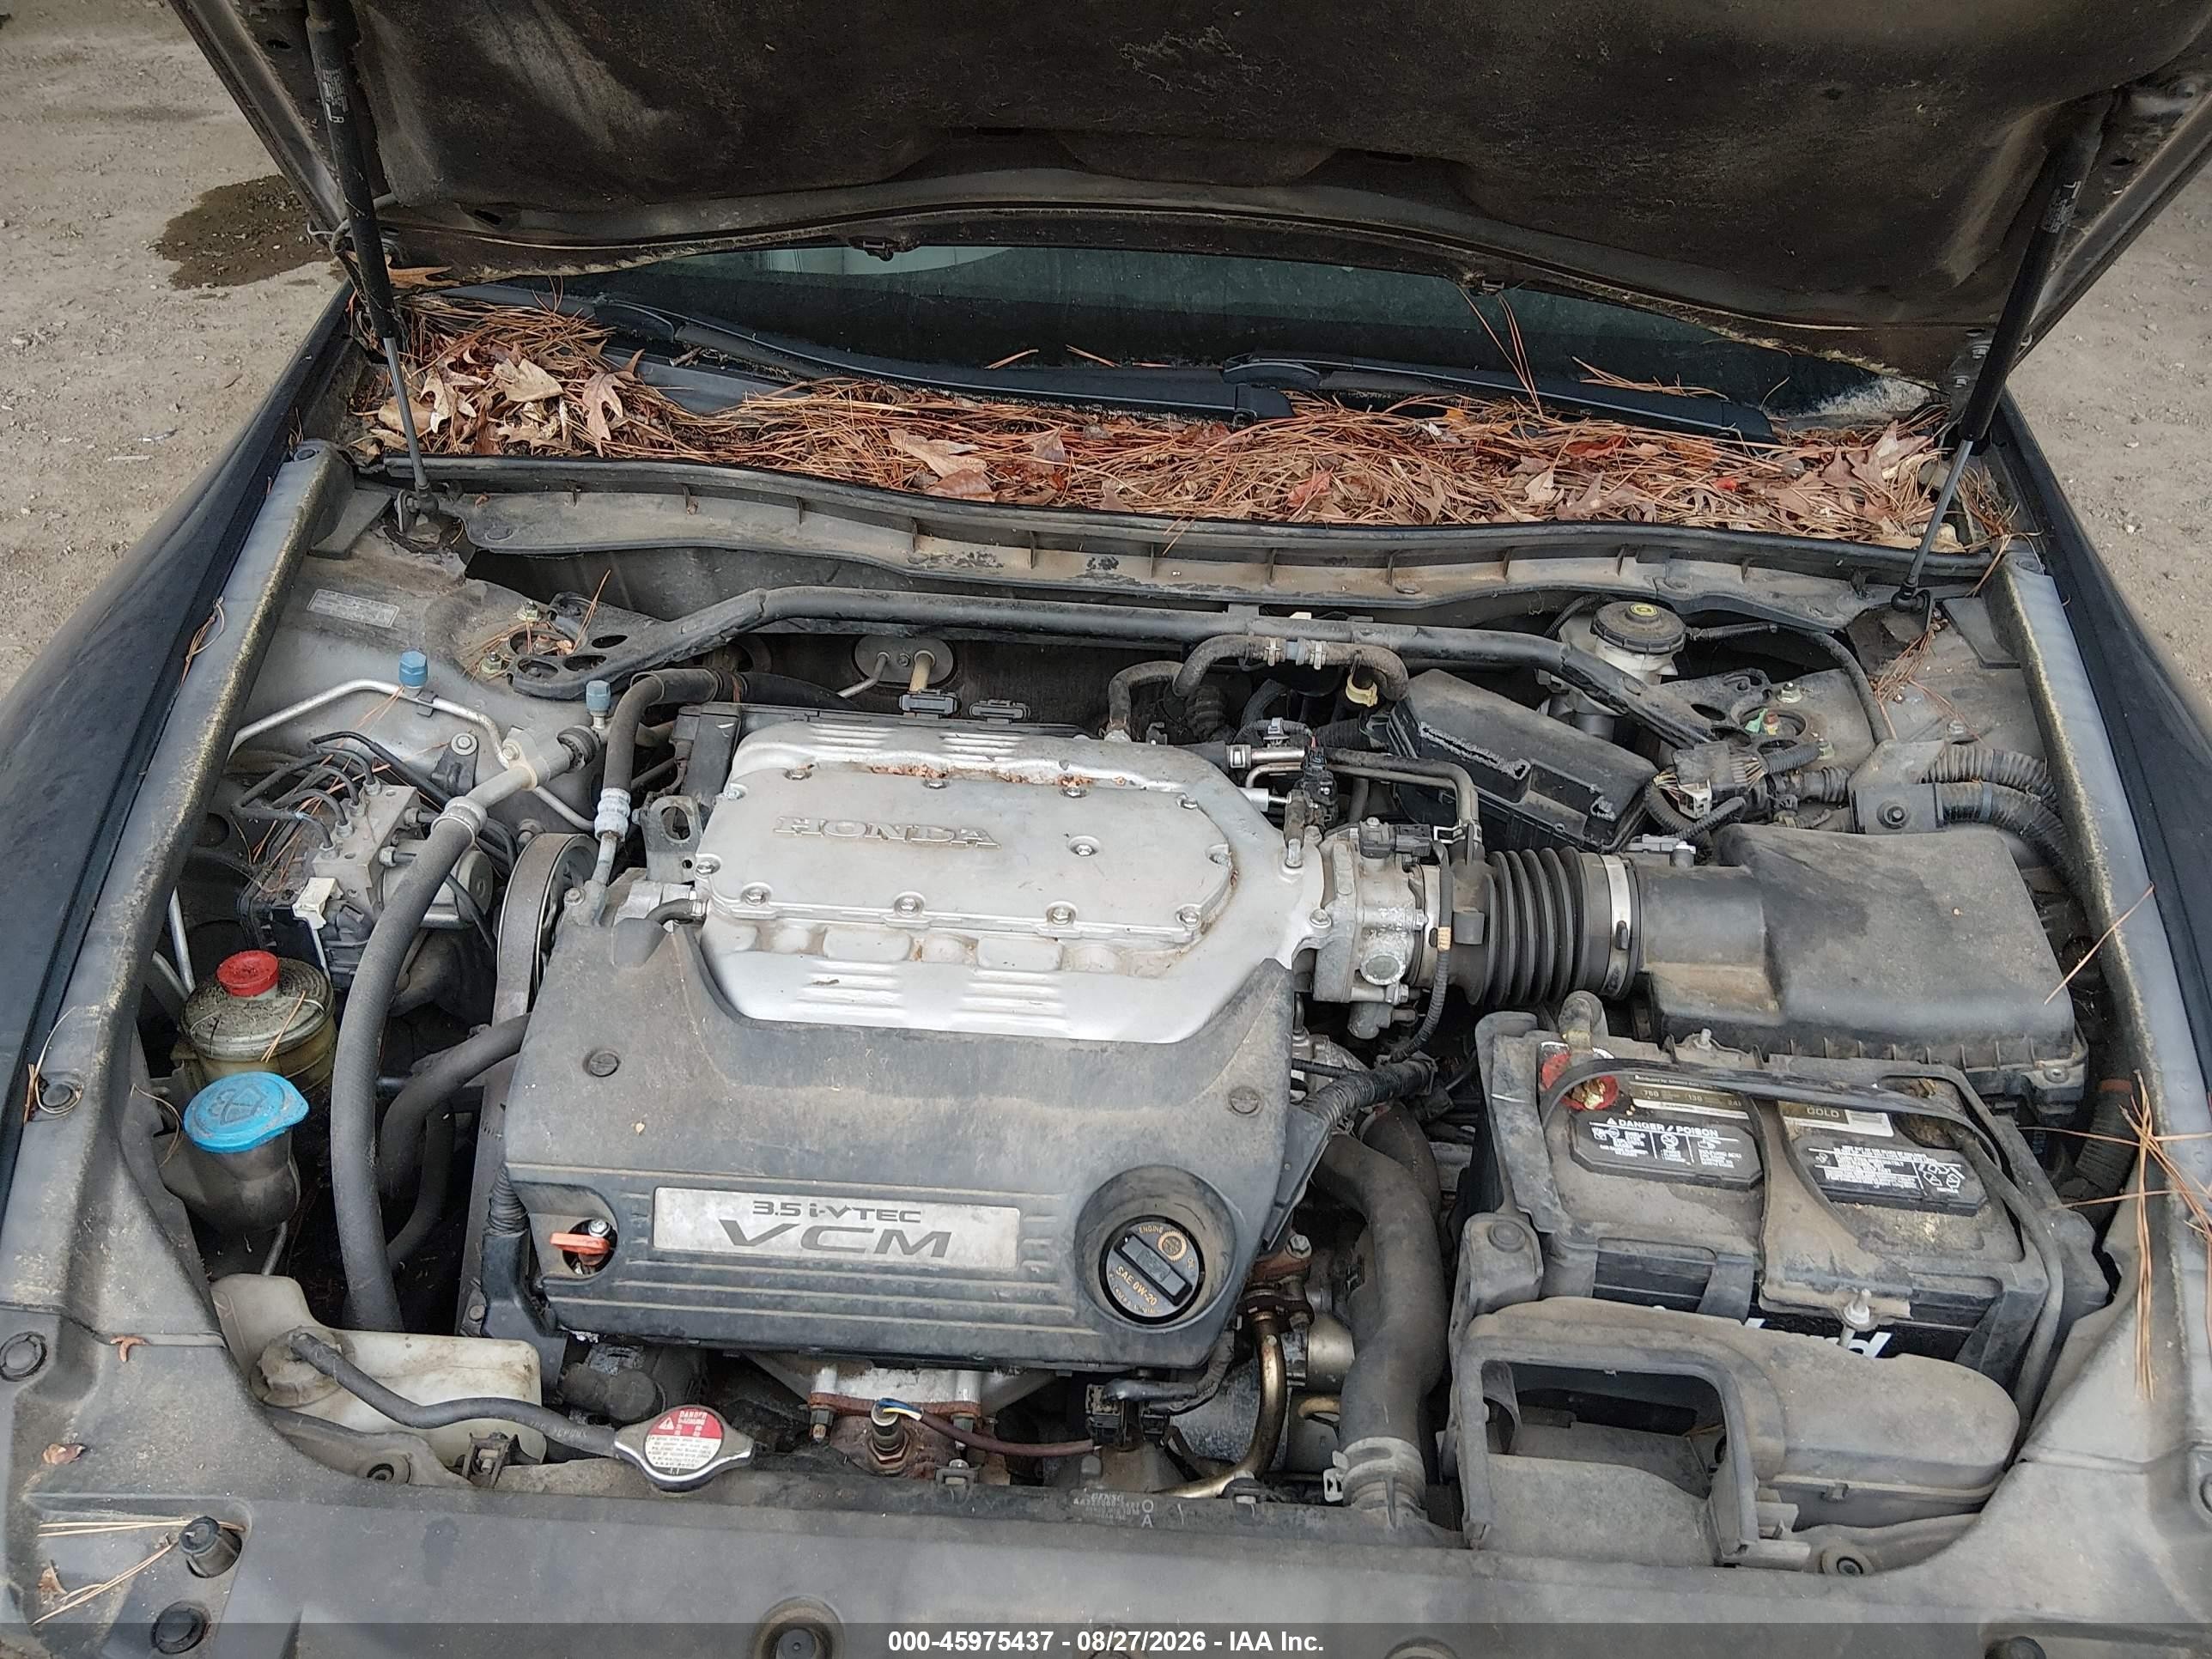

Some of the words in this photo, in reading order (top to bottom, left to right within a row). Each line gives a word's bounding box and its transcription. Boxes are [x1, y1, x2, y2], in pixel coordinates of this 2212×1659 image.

[773, 817, 1002, 849] HONDA
[1807, 1106, 1839, 1119] GOLD
[1618, 1118, 1668, 1133] DANGER
[1675, 1124, 1719, 1138] POISON
[752, 1200, 802, 1218] 3.5
[809, 1202, 921, 1224] i-VTEC
[1139, 1224, 1164, 1235] ENGINE
[719, 1218, 952, 1259] VCM
[1187, 1257, 1196, 1270] OIL
[1116, 1265, 1134, 1285] SAE
[1133, 1281, 1158, 1306] 0W-20
[679, 1410, 708, 1419] DANGER
[1141, 1514, 1154, 1528] A
